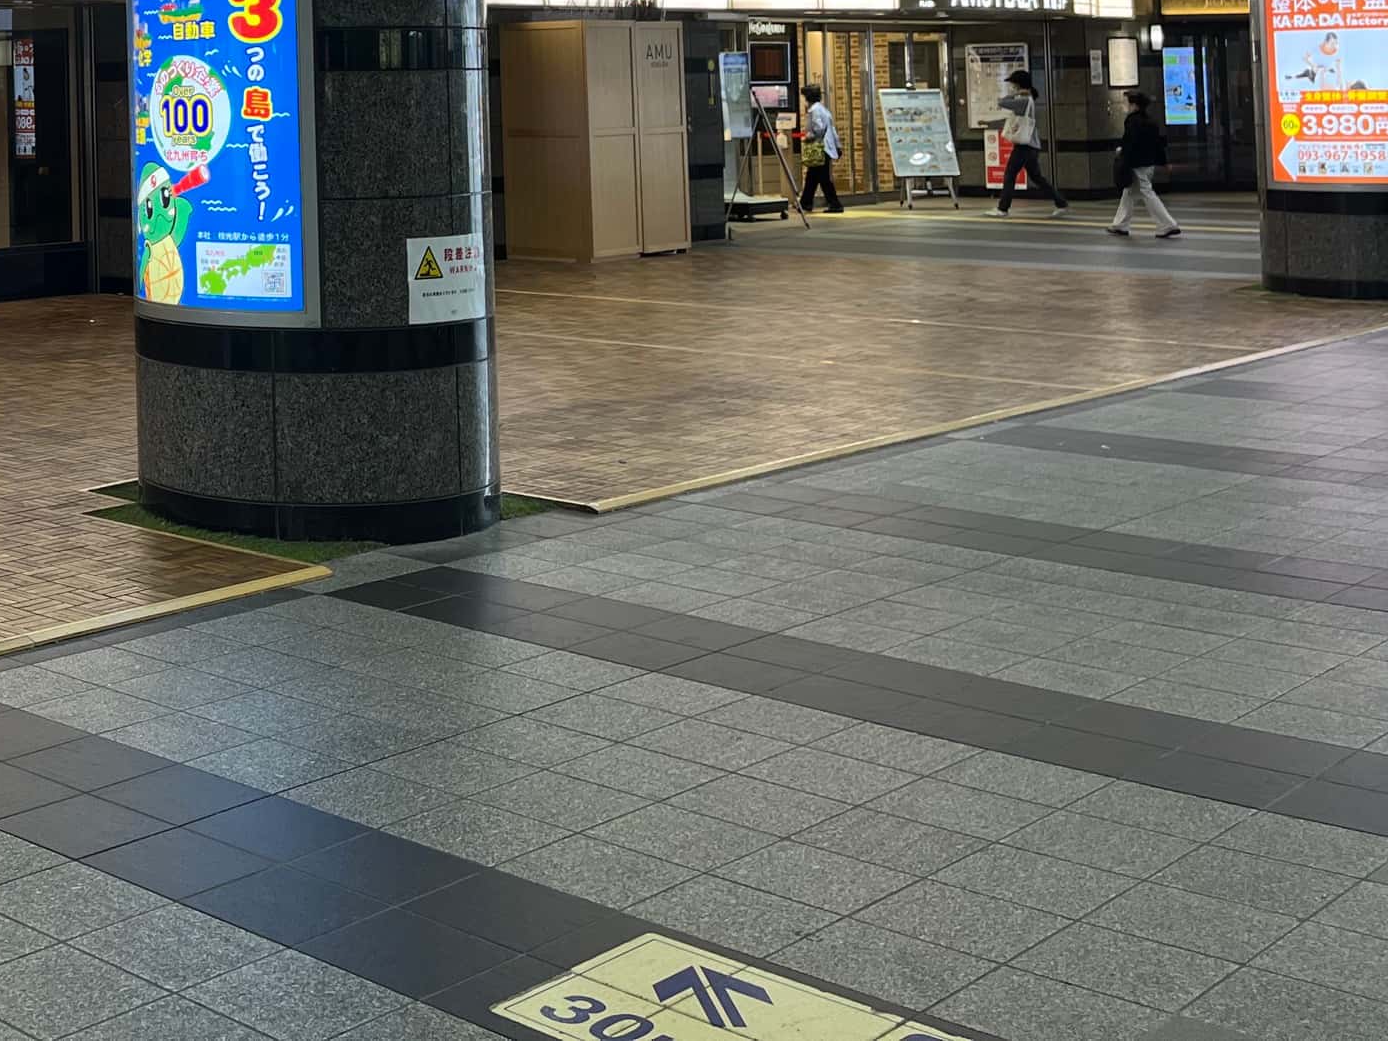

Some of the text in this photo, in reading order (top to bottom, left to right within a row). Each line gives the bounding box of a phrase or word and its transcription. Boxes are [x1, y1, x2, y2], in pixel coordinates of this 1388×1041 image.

[172, 21, 216, 41] 自動車
[645, 43, 673, 60] AMU
[160, 93, 214, 138] 100
